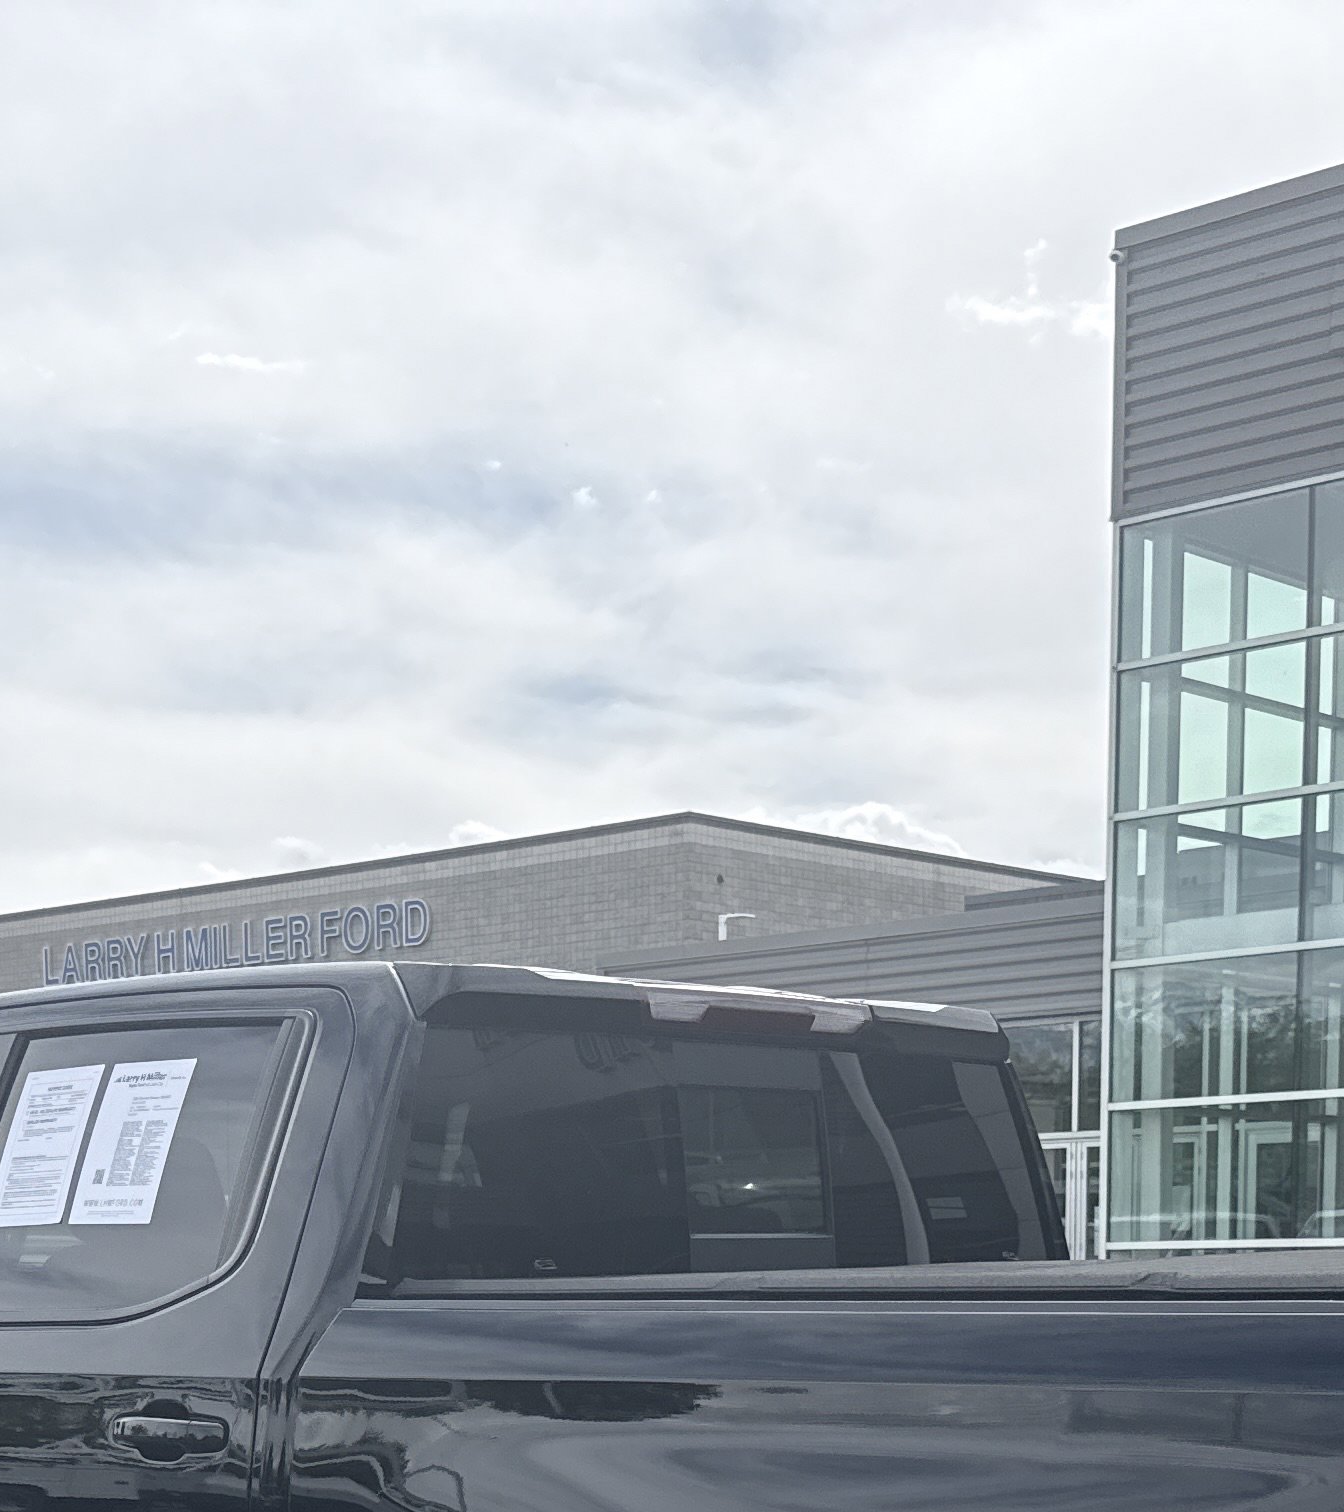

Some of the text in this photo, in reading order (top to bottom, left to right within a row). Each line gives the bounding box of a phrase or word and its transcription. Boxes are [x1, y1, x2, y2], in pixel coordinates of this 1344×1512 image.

[42, 898, 432, 987] LARRY H MILLER FORD
